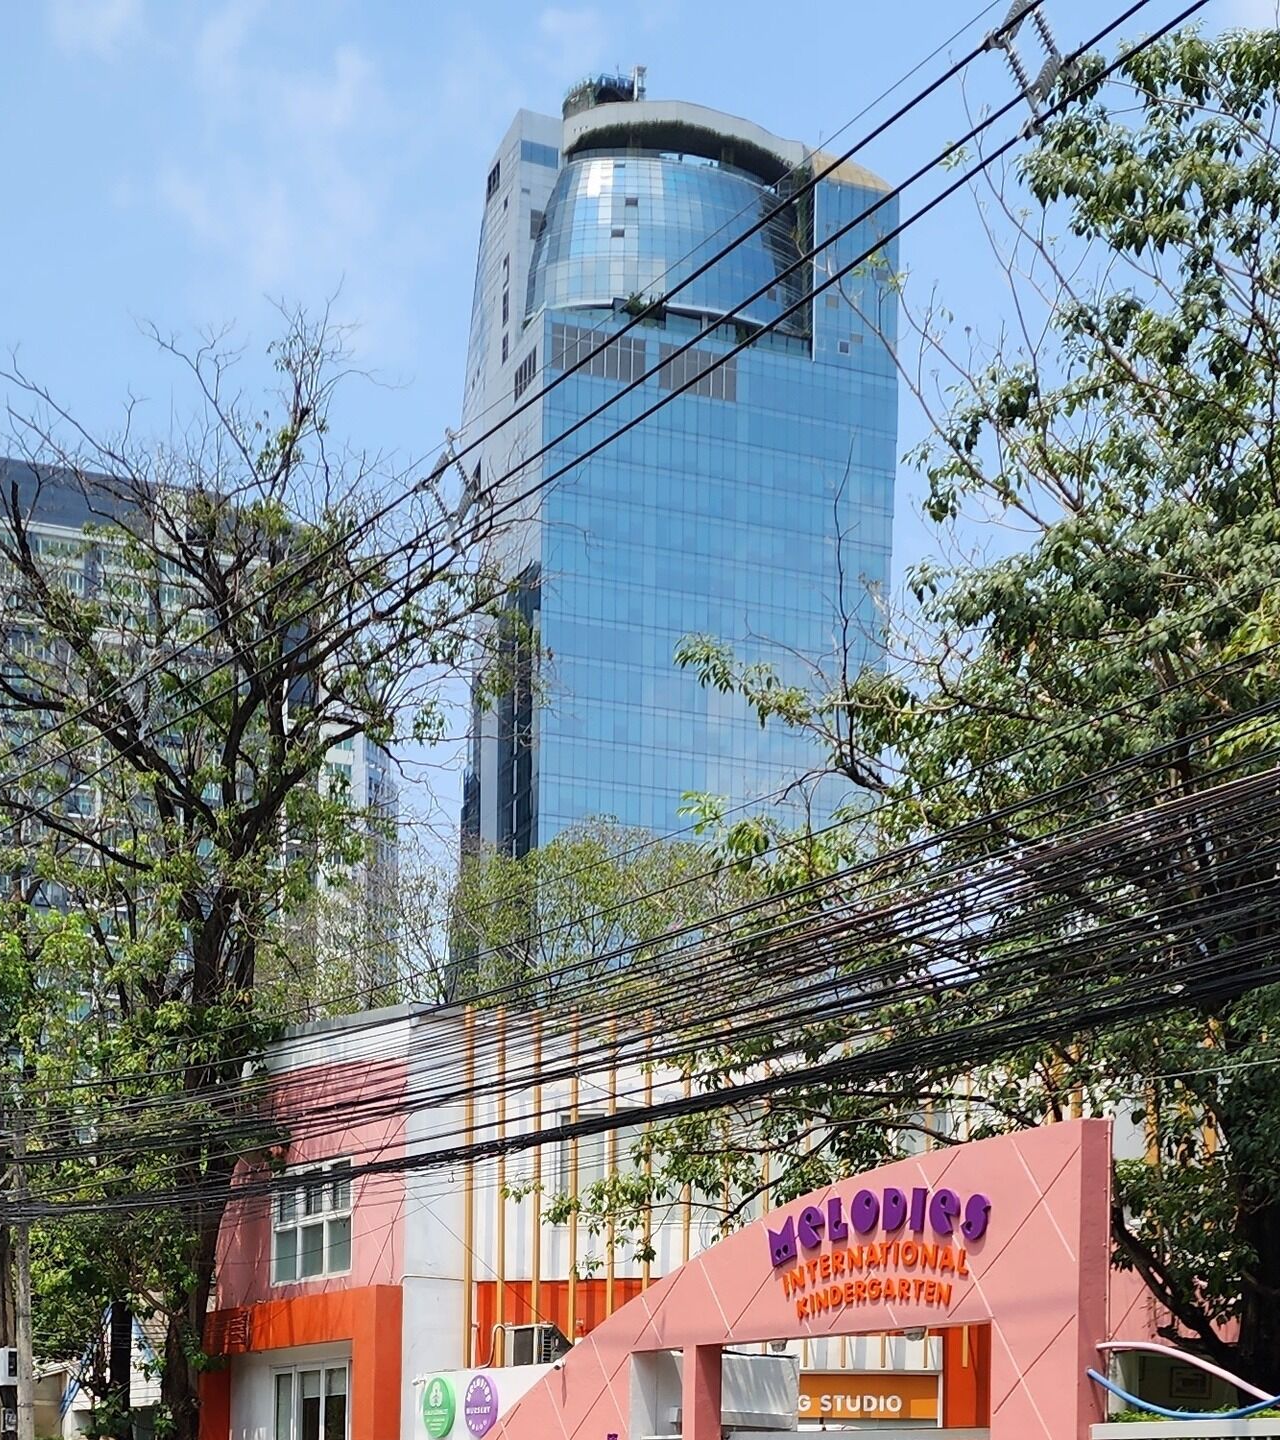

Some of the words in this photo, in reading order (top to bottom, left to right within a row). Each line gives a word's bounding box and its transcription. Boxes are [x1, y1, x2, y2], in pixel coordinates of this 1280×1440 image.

[782, 1240, 970, 1297] INTERNATIONAL
[795, 1279, 953, 1319] KINDERGARTEN
[820, 1394, 902, 1412] STUDIO
